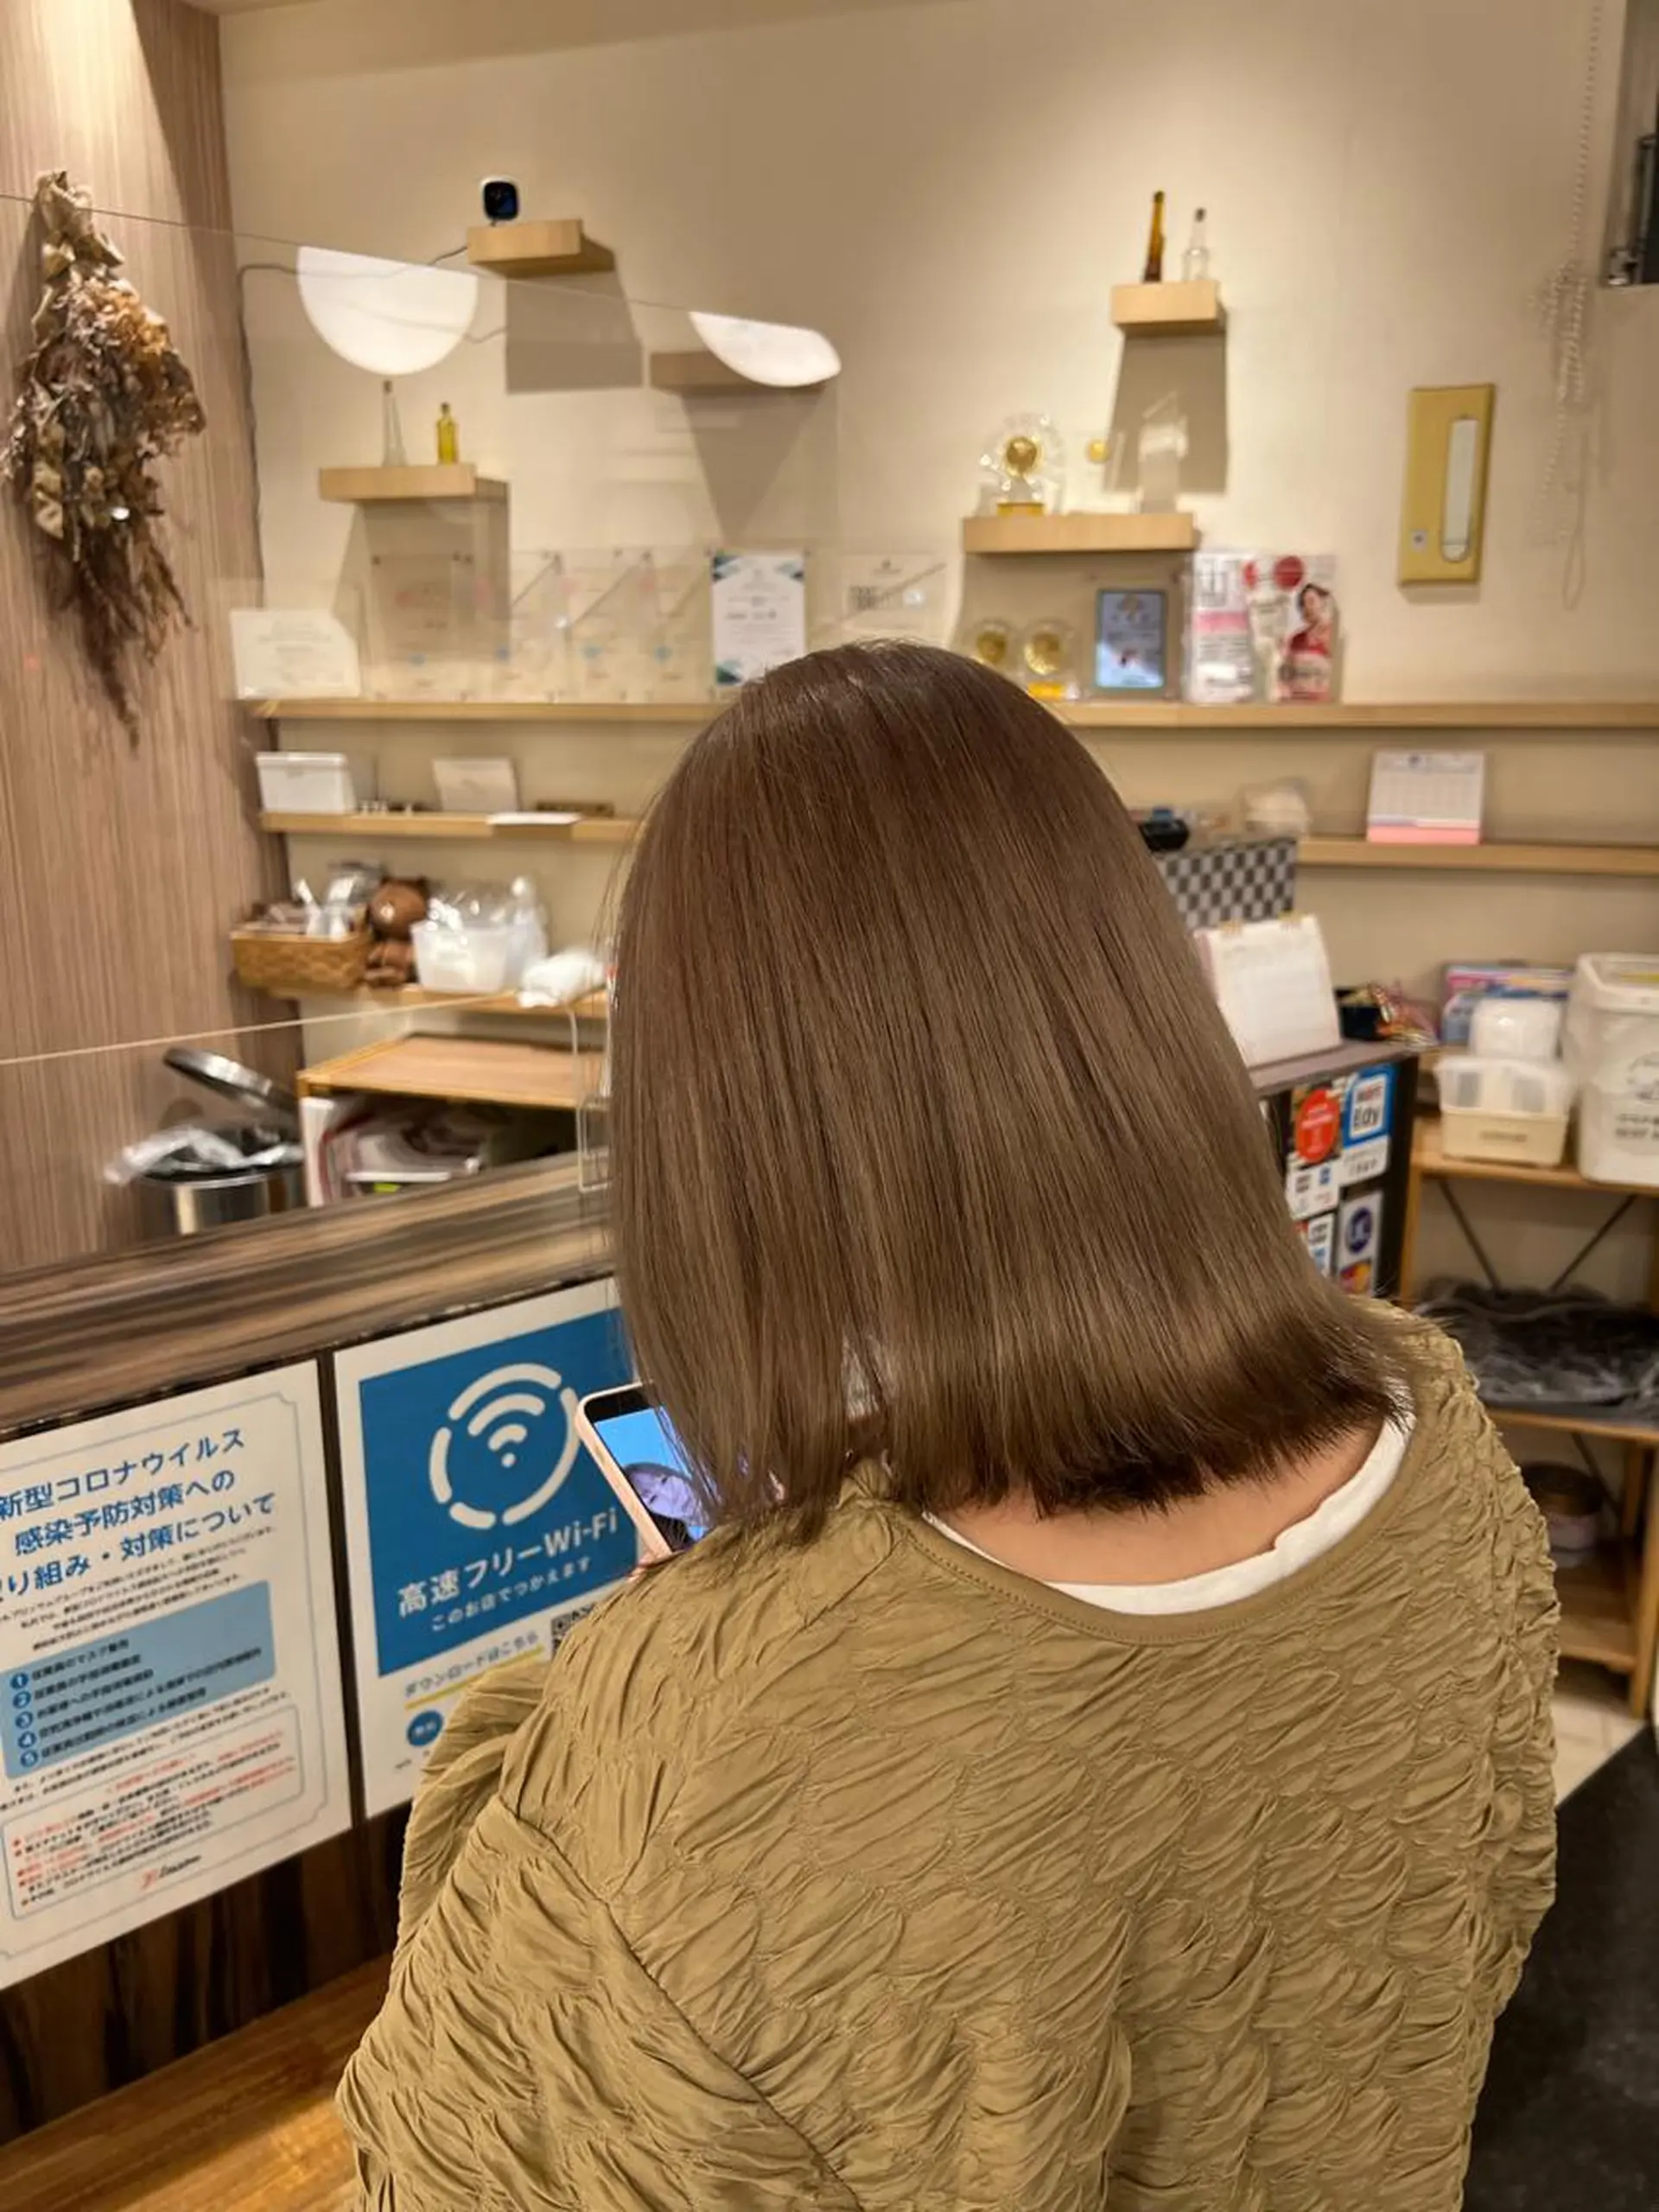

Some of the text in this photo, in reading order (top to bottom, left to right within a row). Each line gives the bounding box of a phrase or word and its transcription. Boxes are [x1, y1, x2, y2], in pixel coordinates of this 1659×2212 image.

[0, 1427, 245, 1522] 新型コロナウイルス
[15, 1469, 235, 1556] 感染予防対策への
[0, 1491, 275, 1597] り組み・対策について
[397, 1506, 618, 1618] 高速フリーWi-Fi
[432, 1556, 591, 1632] このお店でつかえます
